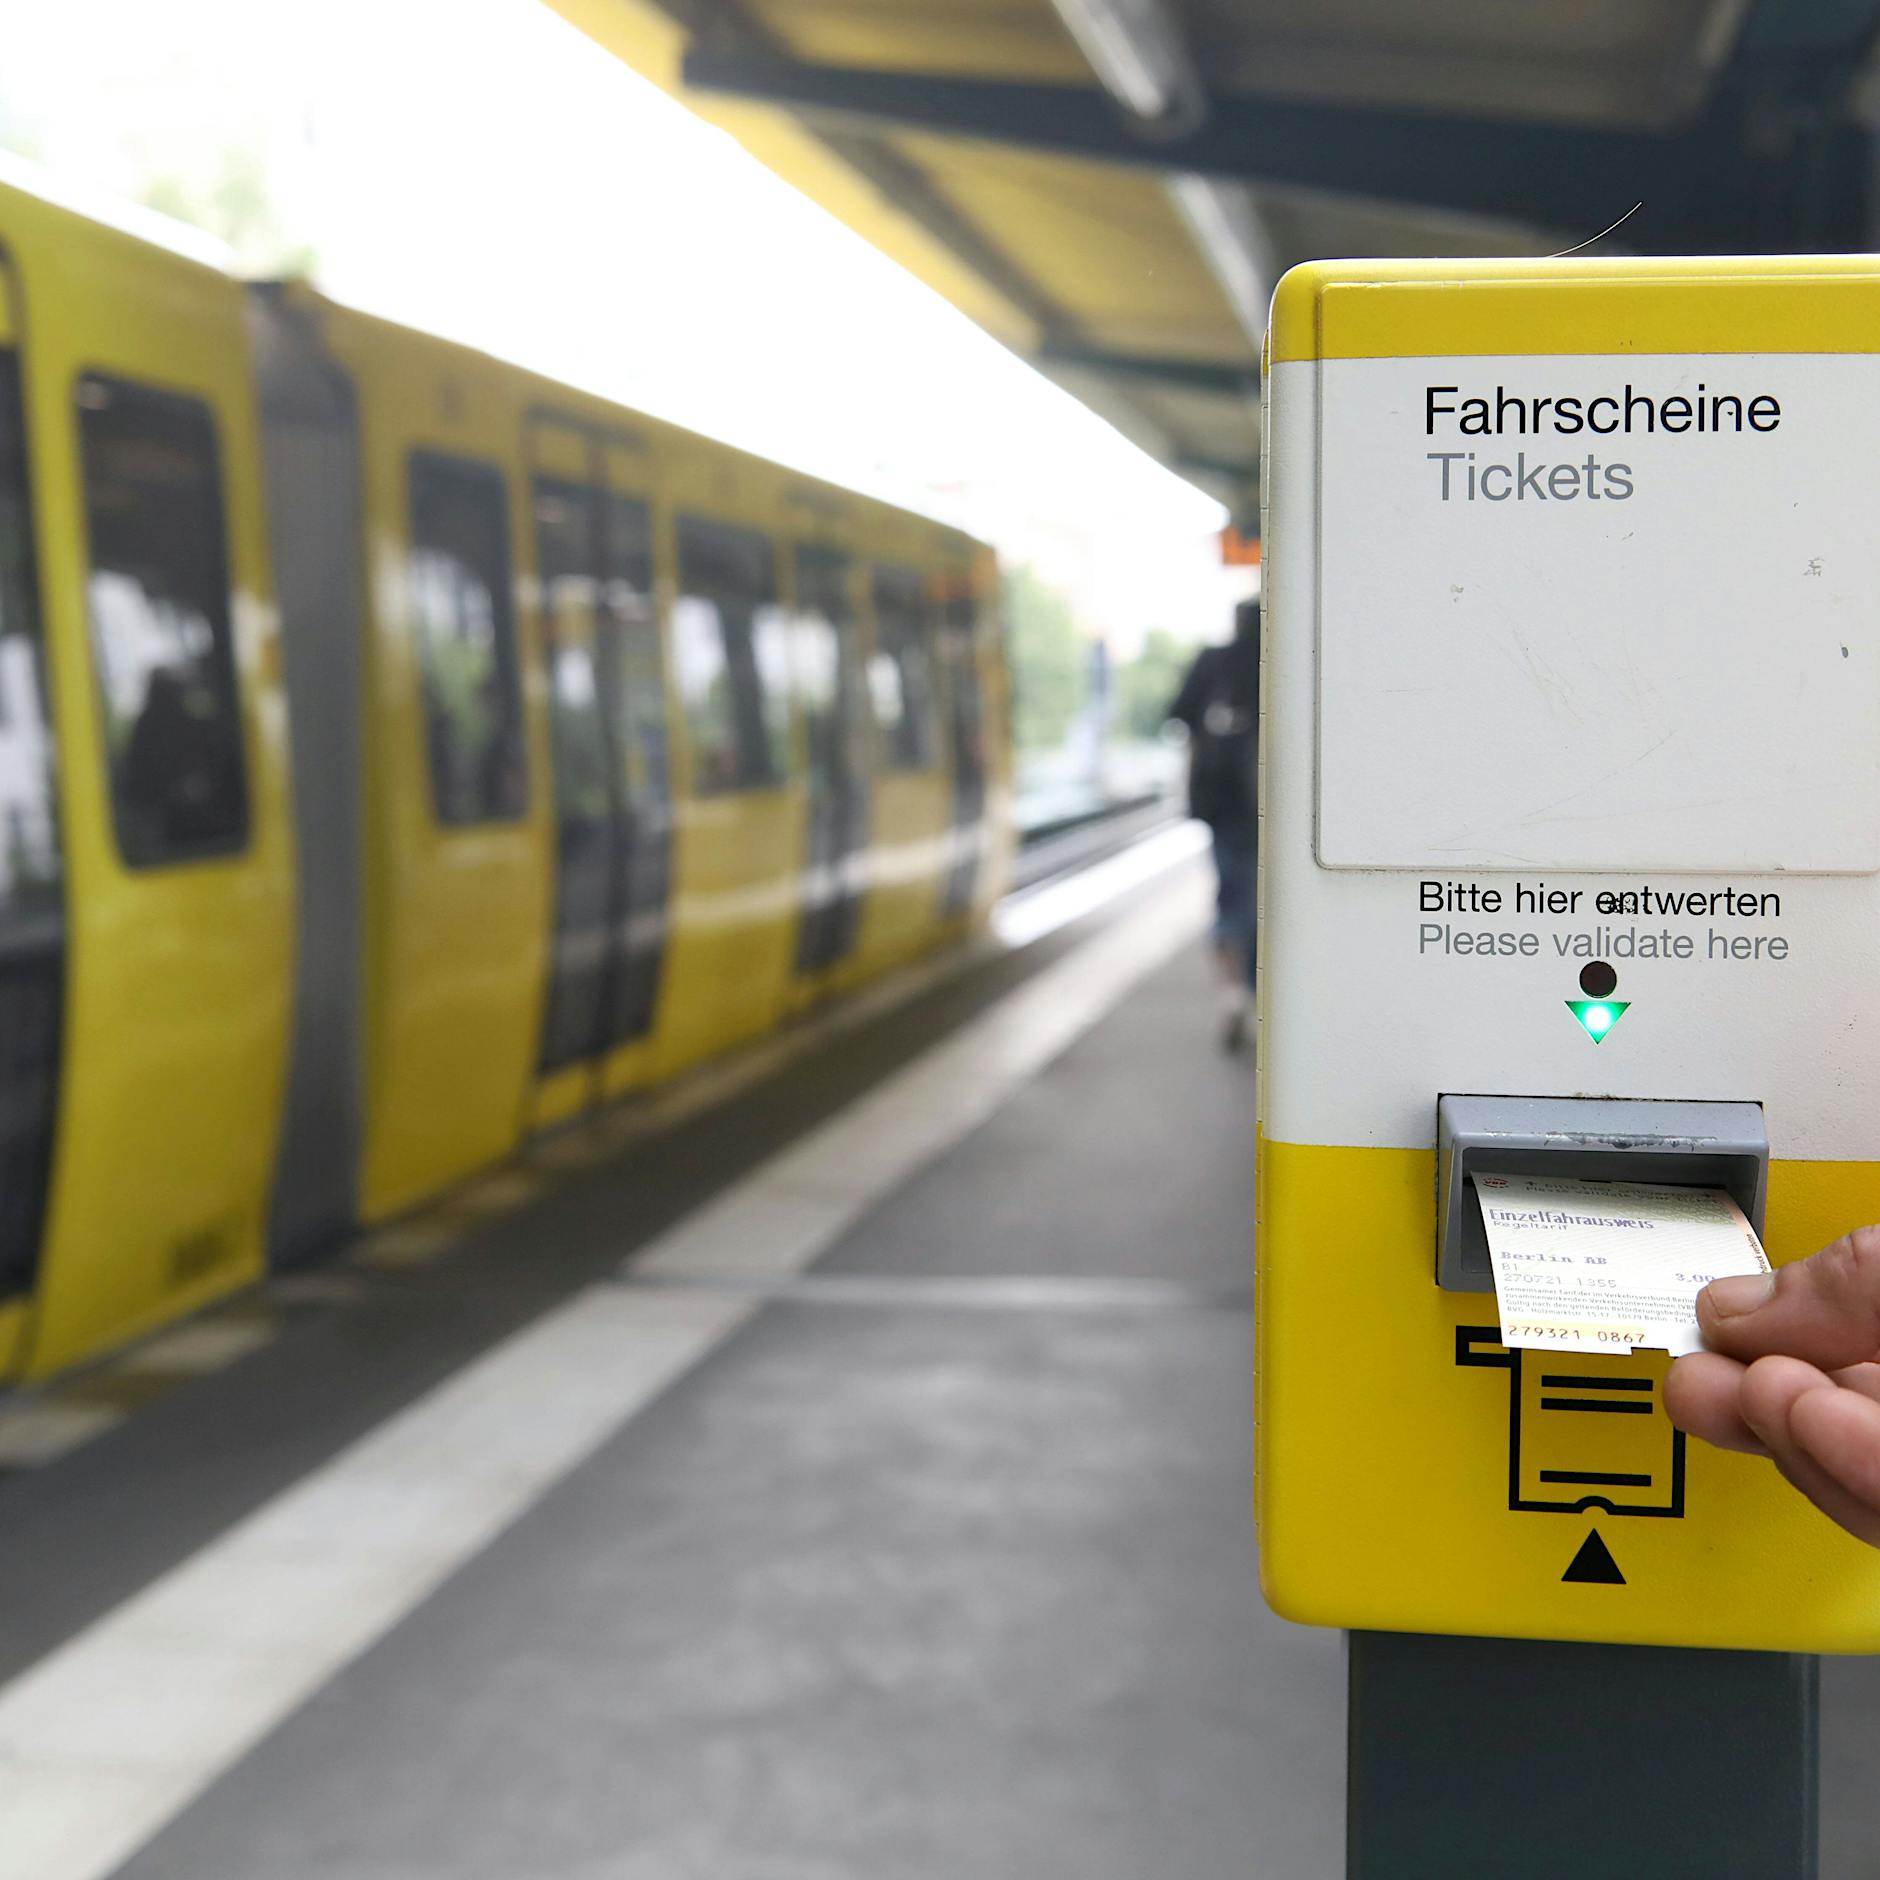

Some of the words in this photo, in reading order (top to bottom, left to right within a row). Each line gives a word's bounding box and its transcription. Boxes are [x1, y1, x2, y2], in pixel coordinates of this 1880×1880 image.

[1427, 383, 1781, 434] Fahrscheine
[1427, 452, 1634, 501] Tickets
[1420, 882, 1502, 913] Bitte
[1516, 883, 1584, 914] hier
[1596, 886, 1780, 916] entwerten
[1419, 923, 1540, 956] Please
[1552, 925, 1695, 959] validate
[1708, 927, 1789, 961] here
[1489, 1208, 1655, 1229] Einzelfahrausweis
[1493, 1220, 1568, 1231] Regeltarif
[1500, 1251, 1574, 1263] Berlin
[1583, 1256, 1608, 1265] AB
[1503, 1272, 1561, 1285] 270721
[1503, 1285, 1557, 1294] Gemeinsamer
[1508, 1325, 1581, 1340] 279321
[1597, 1330, 1647, 1344] 0867
